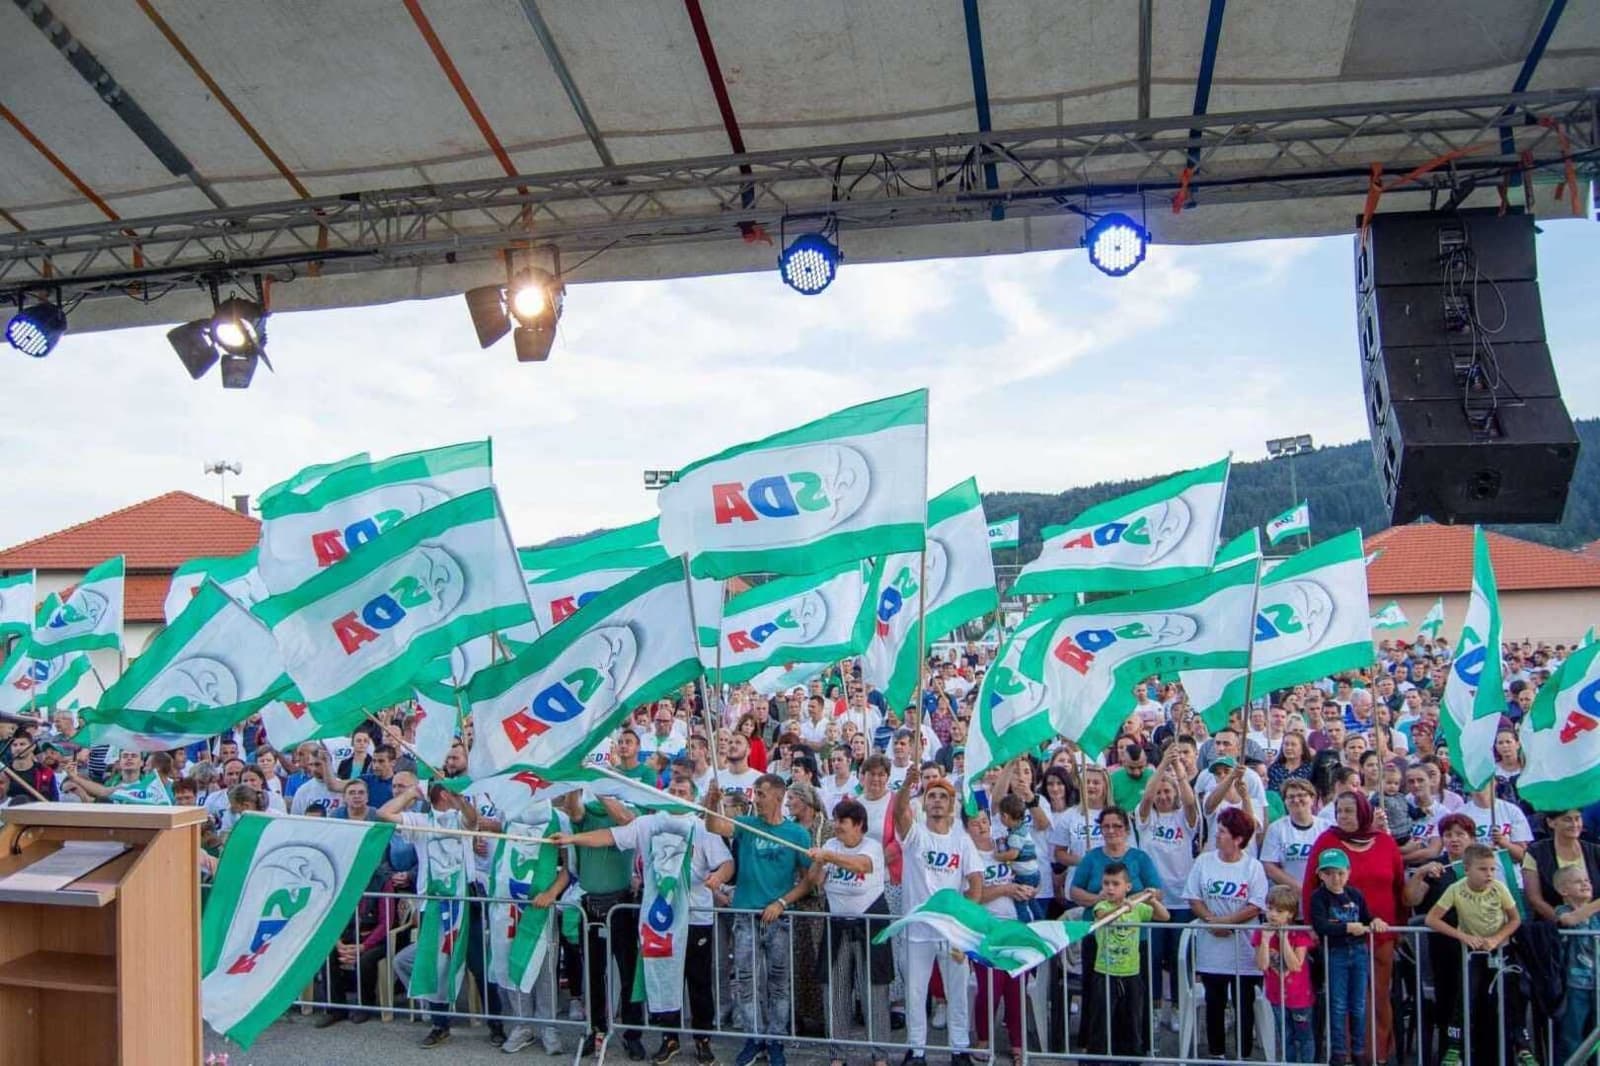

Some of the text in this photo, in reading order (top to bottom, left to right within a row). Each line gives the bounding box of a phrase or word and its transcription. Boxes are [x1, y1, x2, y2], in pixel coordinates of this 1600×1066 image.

[335, 747, 352, 757] SD
[1155, 826, 1184, 839] SDA
[1286, 843, 1313, 857] SD
[927, 850, 960, 869] SDA
[984, 863, 1009, 880] SD
[1209, 880, 1249, 899] SDA
[640, 872, 677, 957] SDA
